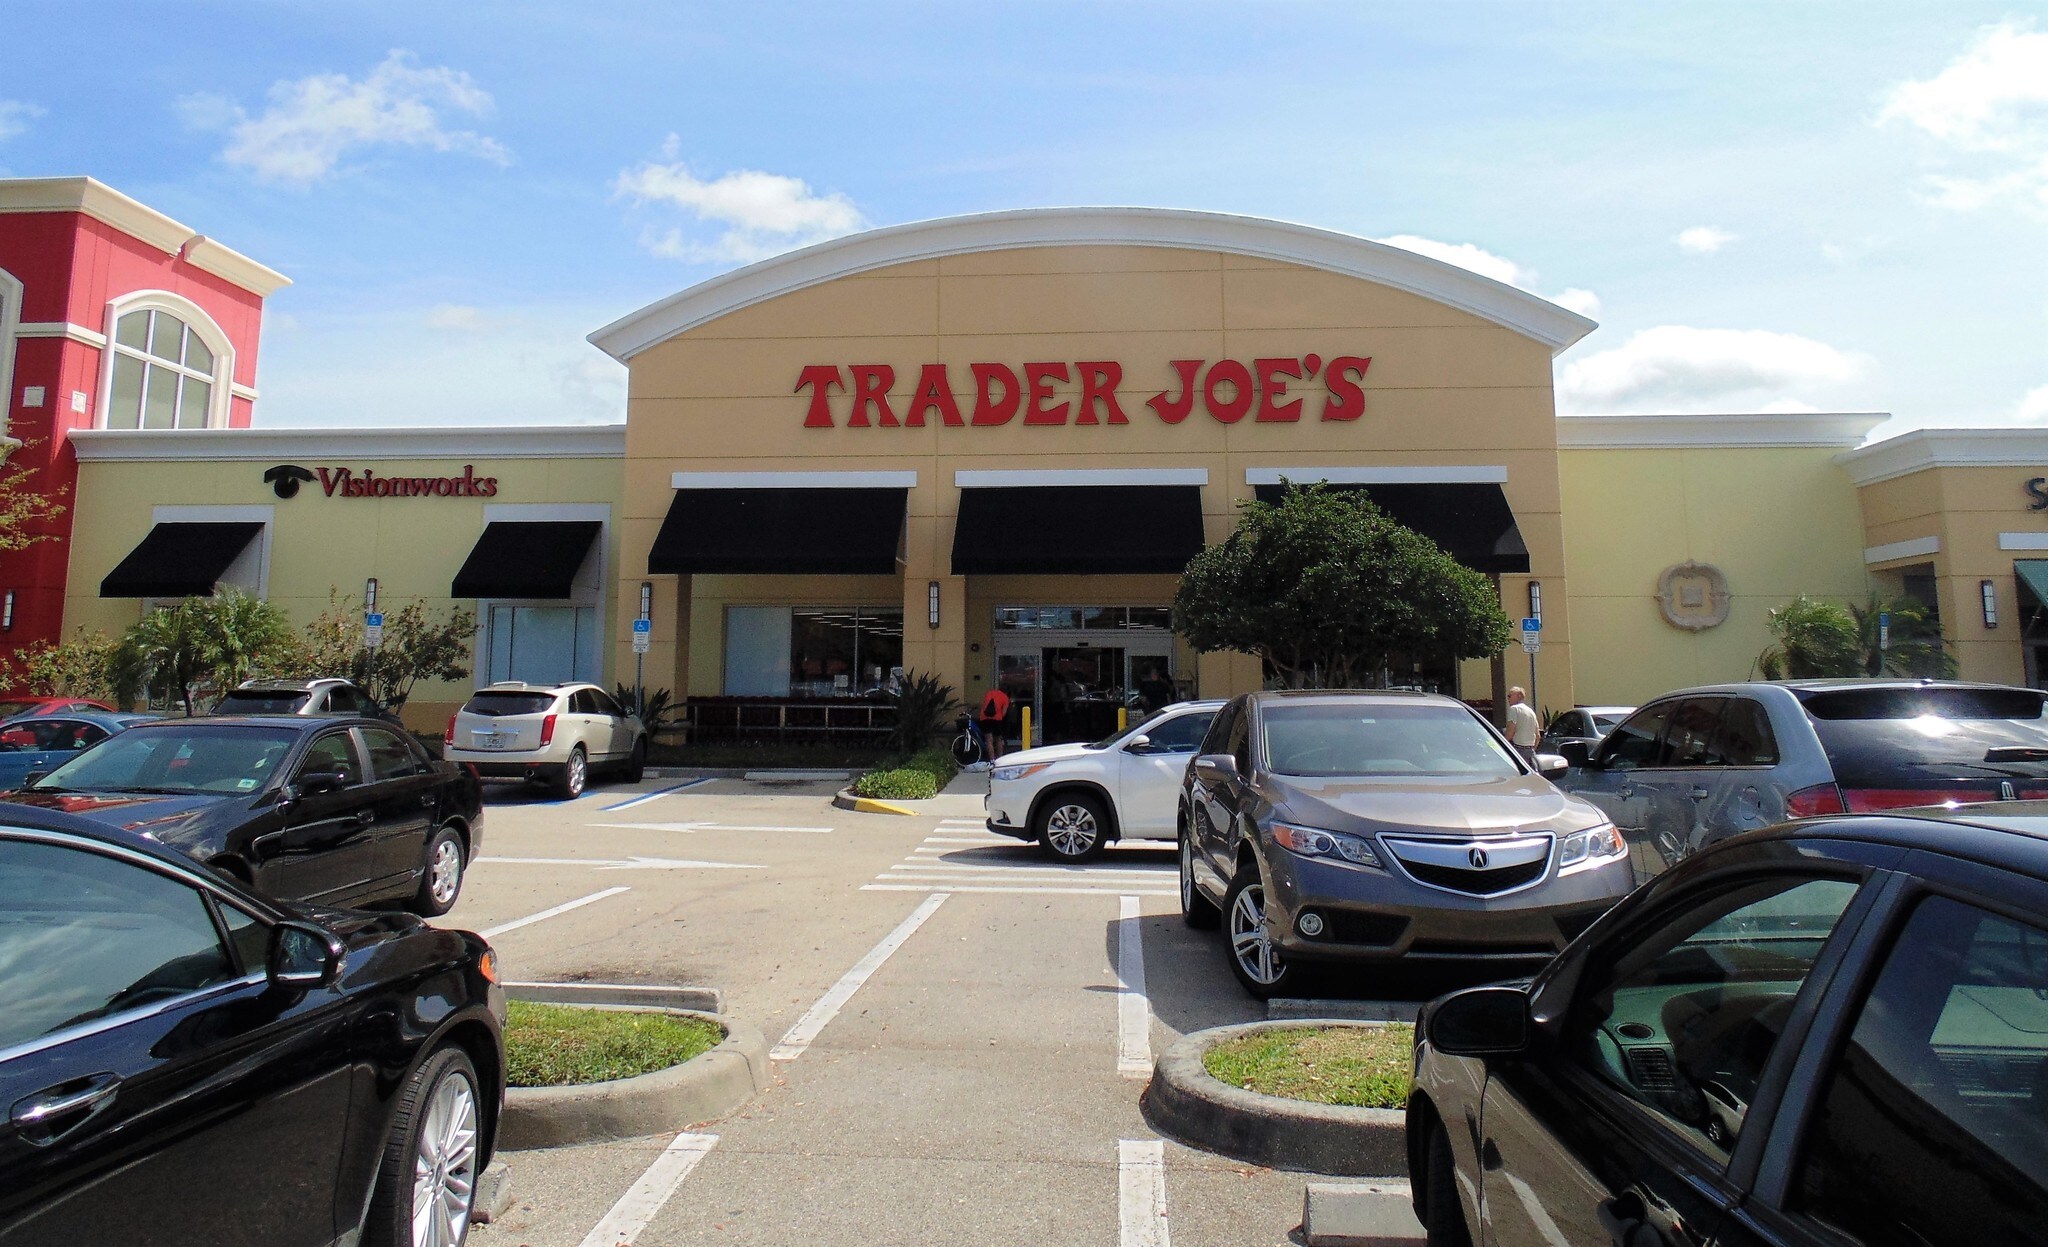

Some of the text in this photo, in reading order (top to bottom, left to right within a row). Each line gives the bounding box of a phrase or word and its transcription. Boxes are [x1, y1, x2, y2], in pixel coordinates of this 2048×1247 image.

[794, 353, 1373, 428] TRADER JOE'S
[314, 464, 498, 498] Visionworks
